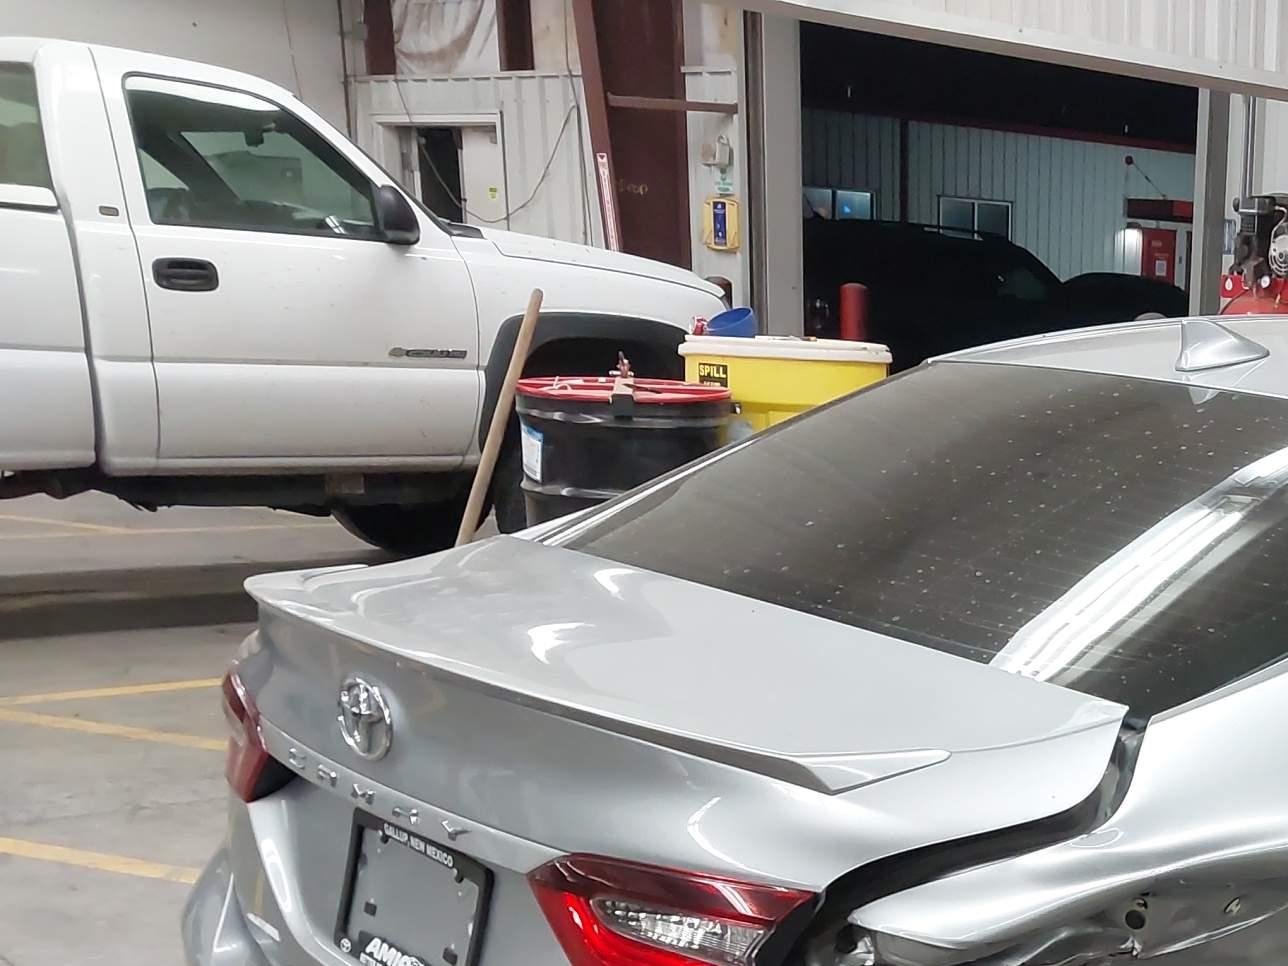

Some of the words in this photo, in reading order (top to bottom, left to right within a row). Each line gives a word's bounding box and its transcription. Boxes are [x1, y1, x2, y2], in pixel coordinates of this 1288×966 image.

[700, 364, 726, 378] SPILL
[410, 835, 425, 853] NEW
[426, 843, 453, 868] MEXICO
